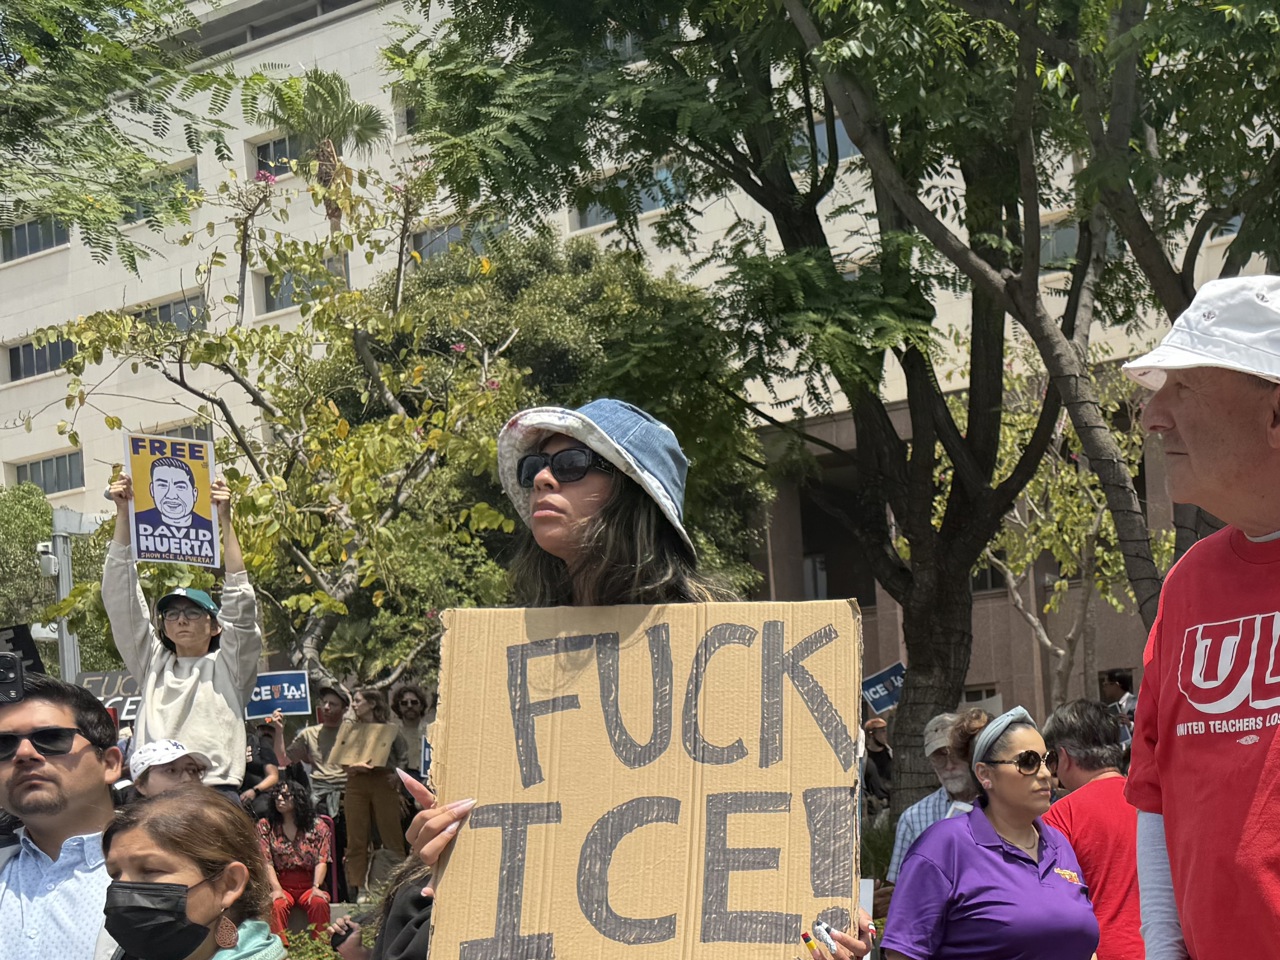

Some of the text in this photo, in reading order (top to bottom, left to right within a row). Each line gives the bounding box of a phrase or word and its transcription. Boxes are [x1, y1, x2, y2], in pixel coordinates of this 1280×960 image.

[131, 437, 205, 460] FREE
[138, 524, 212, 541] DAVID
[139, 535, 214, 557] HUERTA
[82, 675, 141, 698] FUC
[251, 685, 272, 702] CE
[507, 620, 854, 789] FUCK
[1176, 721, 1205, 736] UNITED
[1209, 716, 1263, 733] TEACHERS
